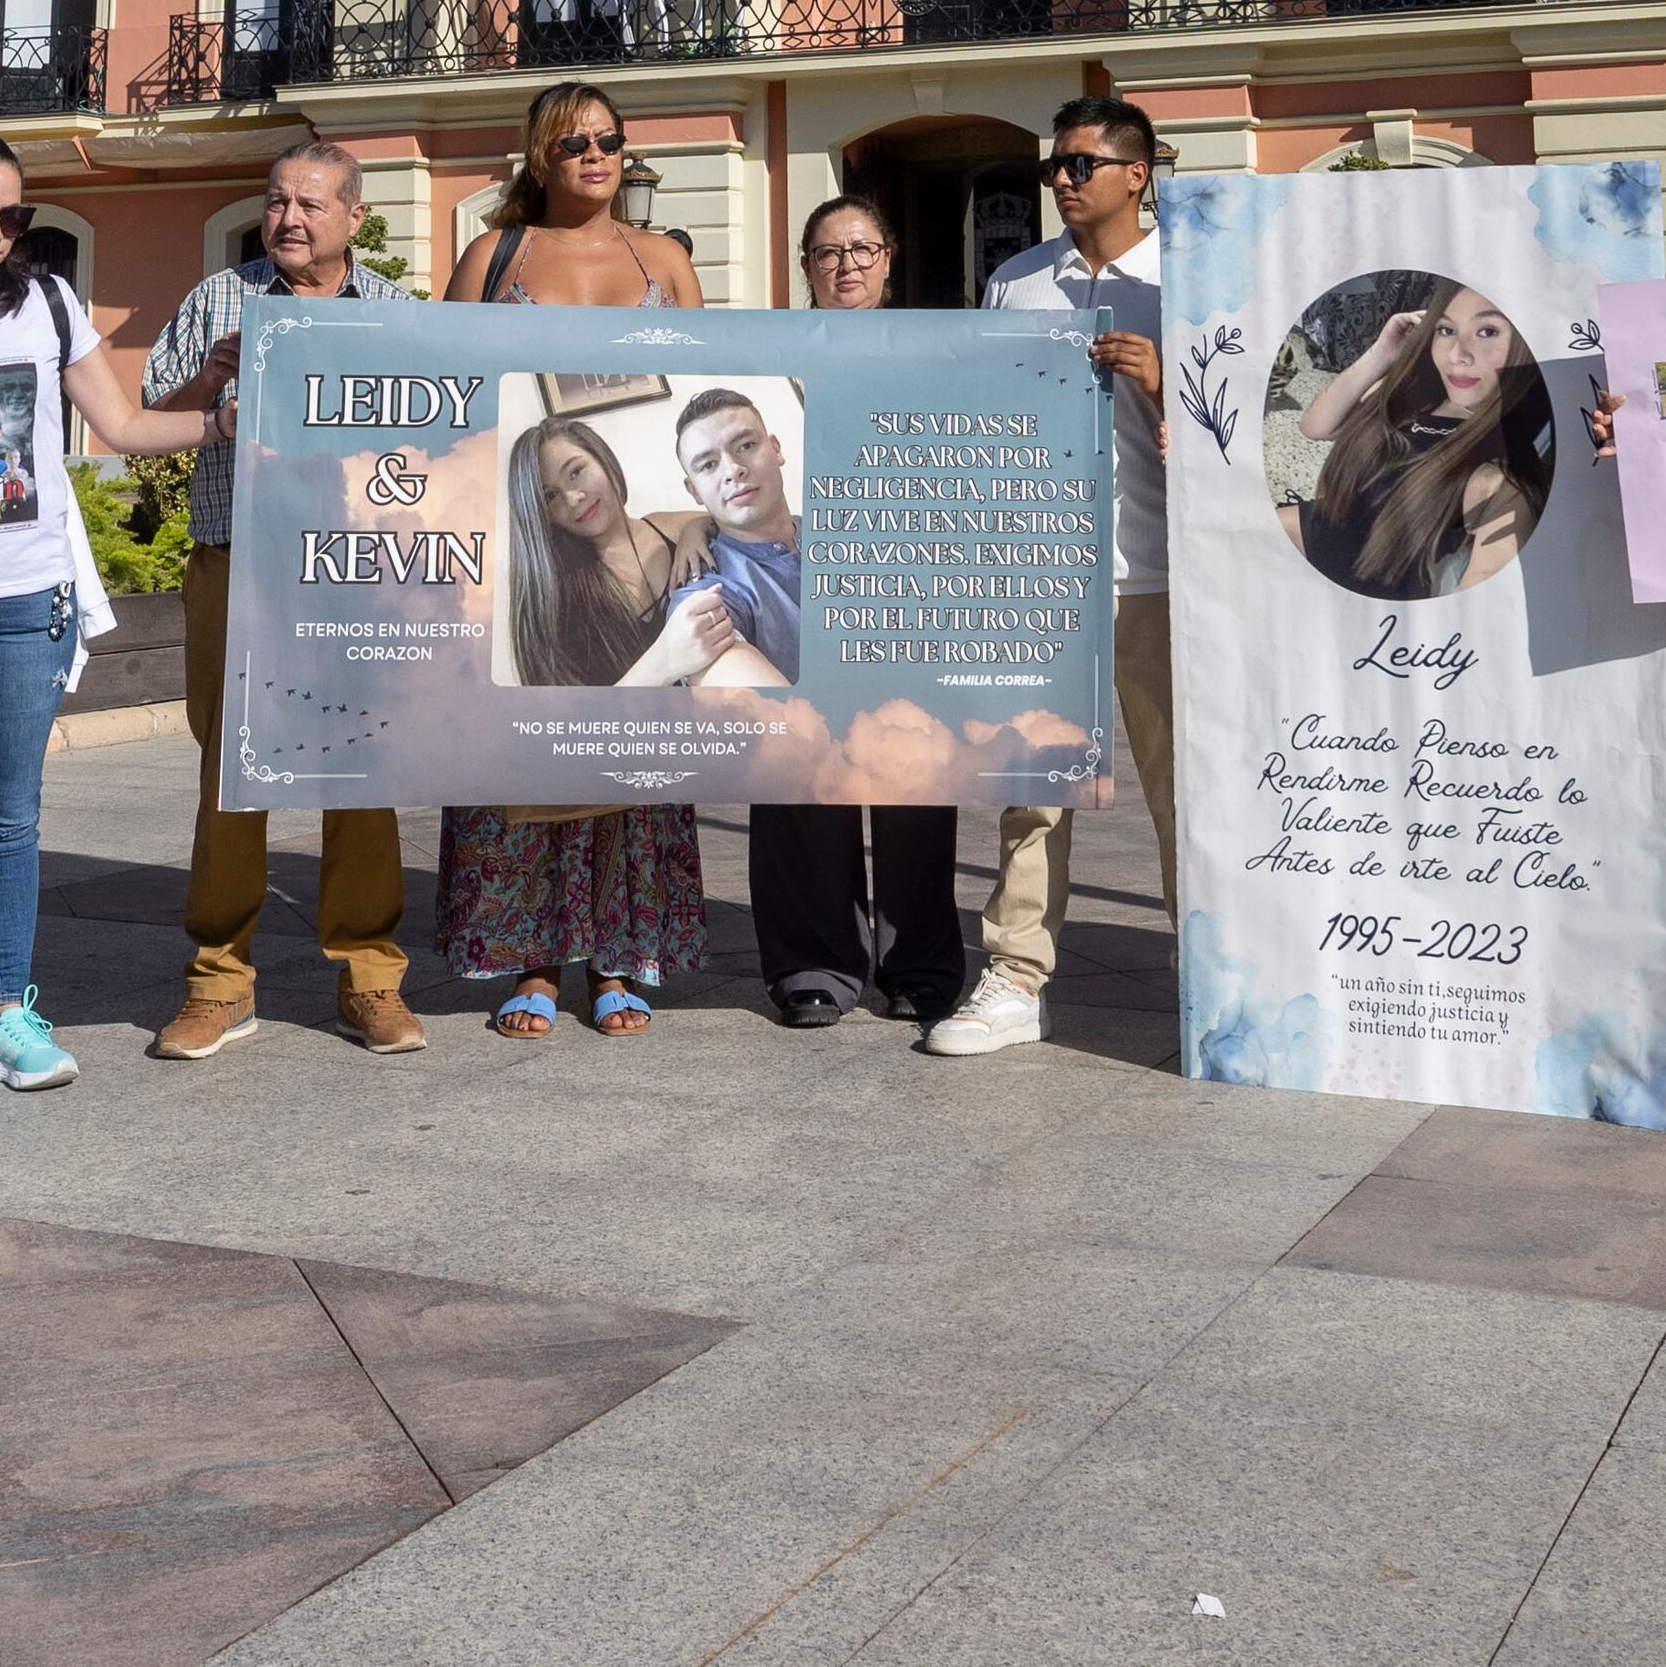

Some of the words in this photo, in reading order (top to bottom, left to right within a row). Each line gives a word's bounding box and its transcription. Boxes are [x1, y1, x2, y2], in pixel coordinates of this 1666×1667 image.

[303, 374, 484, 428] LEIDY
[869, 412, 925, 436] "SUS
[928, 413, 1003, 437] VIDAS
[1006, 414, 1038, 438] SE
[854, 445, 994, 469] APAGARON
[999, 446, 1052, 469] POR
[366, 452, 429, 506] &
[809, 477, 985, 504] NEGLIGENCIA,
[990, 479, 1058, 501] PERO
[1062, 479, 1096, 502] SU
[811, 509, 859, 532] LUZ
[861, 510, 919, 533] VIVE
[924, 510, 957, 533] EN
[961, 511, 1094, 534] NUESTROS
[300, 531, 485, 585] KEVIN
[807, 541, 970, 565] CORAZONES.
[974, 543, 1098, 566] EXIGIMOS
[809, 574, 927, 601] JUSTICIA,
[931, 575, 985, 598] POR
[989, 576, 1071, 599] ELLOS
[1072, 577, 1092, 599] Y
[295, 622, 374, 638] ETERNOS
[378, 623, 400, 638] EN
[405, 623, 485, 638] NUESTRO
[823, 606, 878, 631] POR
[881, 607, 912, 631] EL
[916, 607, 1020, 631] FUTURO
[1023, 609, 1081, 635] QUE
[346, 645, 432, 661] CORAZON
[840, 640, 886, 663] LES
[889, 640, 940, 663] FUE
[943, 640, 1063, 664] ROBADO"
[1353, 614, 1479, 691] Leidy
[546, 722, 564, 735] SE
[569, 721, 620, 735] MUERE
[623, 721, 671, 737] QUIEN
[674, 722, 692, 735] SE
[696, 721, 720, 736] VA,
[723, 721, 765, 735] SOLO
[769, 721, 788, 735] SE
[1414, 719, 1510, 760] Pienso
[1524, 742, 1559, 760] en
[553, 742, 604, 755] MUERE
[608, 742, 655, 757] QUIEN
[659, 742, 677, 755] SE
[1257, 752, 1389, 794] Rendirme
[1404, 759, 1545, 802] Recuerdo
[1558, 778, 1589, 805] lo
[1281, 797, 1393, 835] Valiente
[1406, 822, 1462, 852] que
[1476, 807, 1564, 846] Fuiste
[1245, 836, 1335, 875] Antes
[1349, 851, 1387, 877] de
[1400, 857, 1453, 881] irte
[1466, 858, 1503, 884] al
[1319, 912, 1530, 965] 1995-2023
[1364, 977, 1396, 994] año
[1398, 979, 1424, 996] sin
[1348, 999, 1426, 1019] exigiendo
[1428, 1002, 1495, 1023] justicia
[1498, 1011, 1509, 1029] y
[1348, 1020, 1426, 1039] sintiendo
[1430, 1027, 1448, 1040] tu
